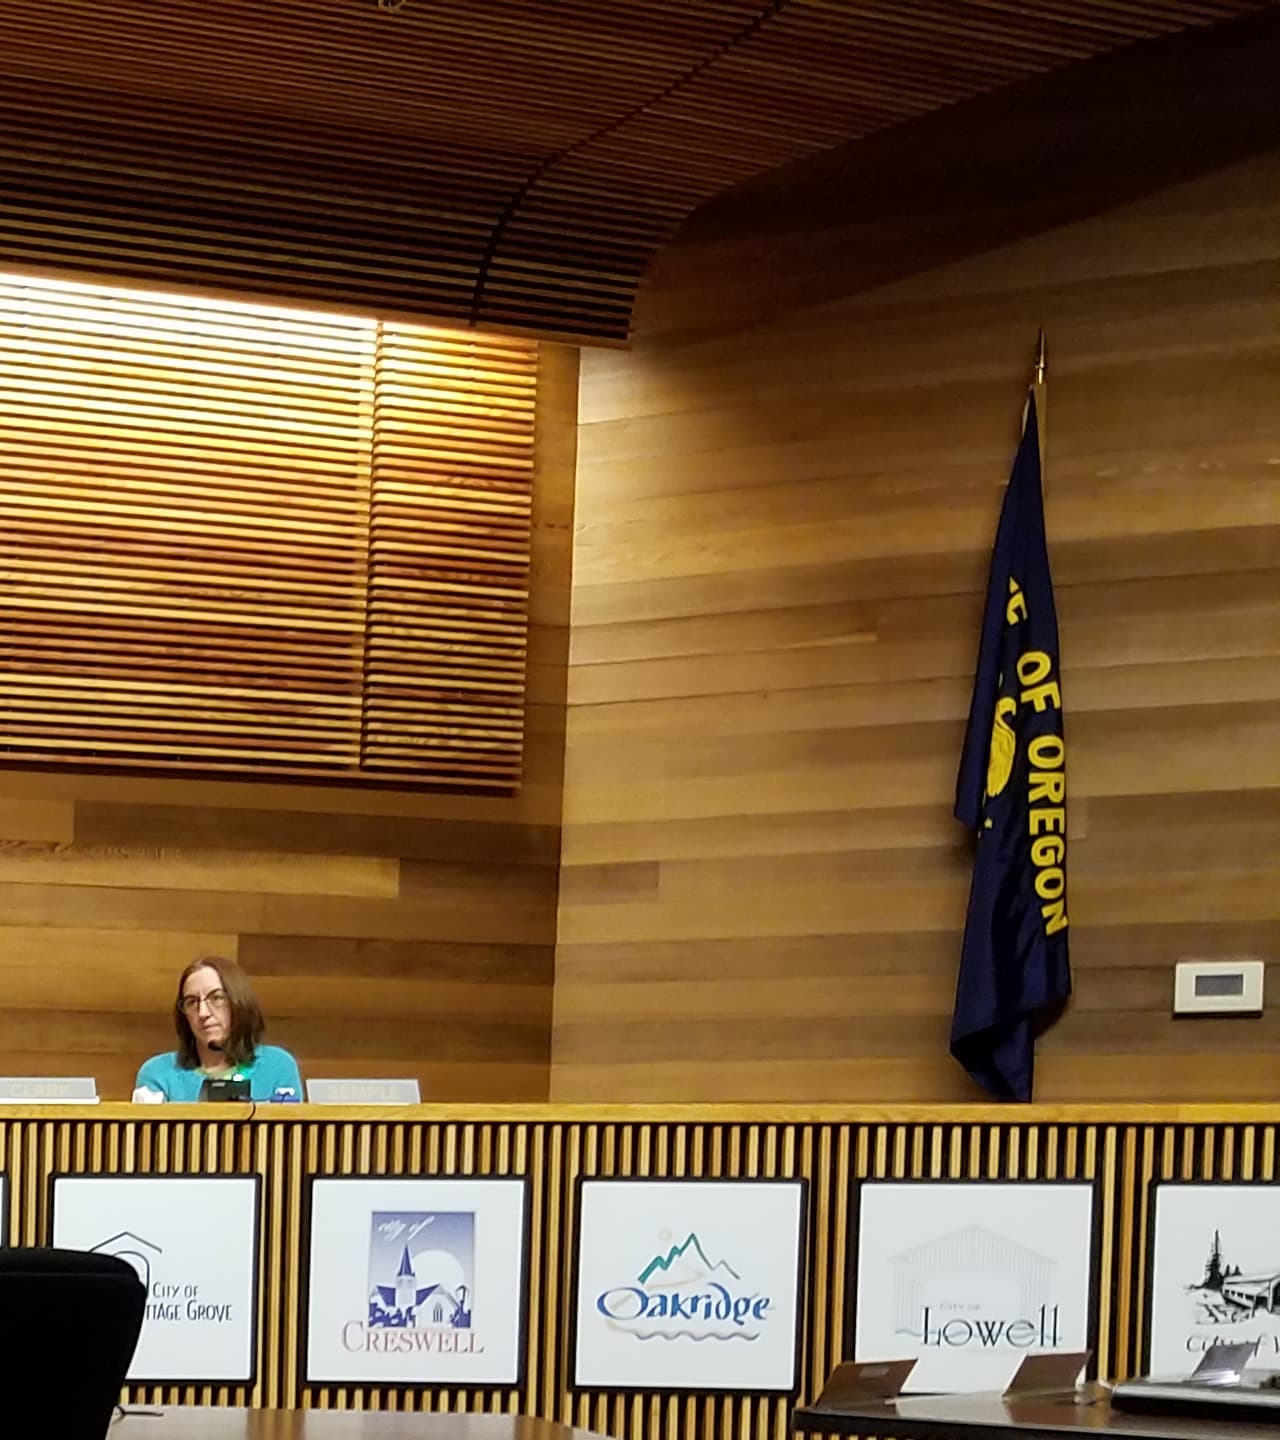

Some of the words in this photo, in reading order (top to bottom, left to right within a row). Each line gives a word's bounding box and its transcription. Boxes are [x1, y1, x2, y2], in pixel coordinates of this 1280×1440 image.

[1016, 651, 1061, 713] OF
[1027, 735, 1068, 936] OREGON
[10, 1083, 72, 1097] CLARK
[597, 1282, 770, 1326] Oakridge
[923, 1294, 1058, 1348] Lowell
[342, 1319, 484, 1353] CRESWELL
